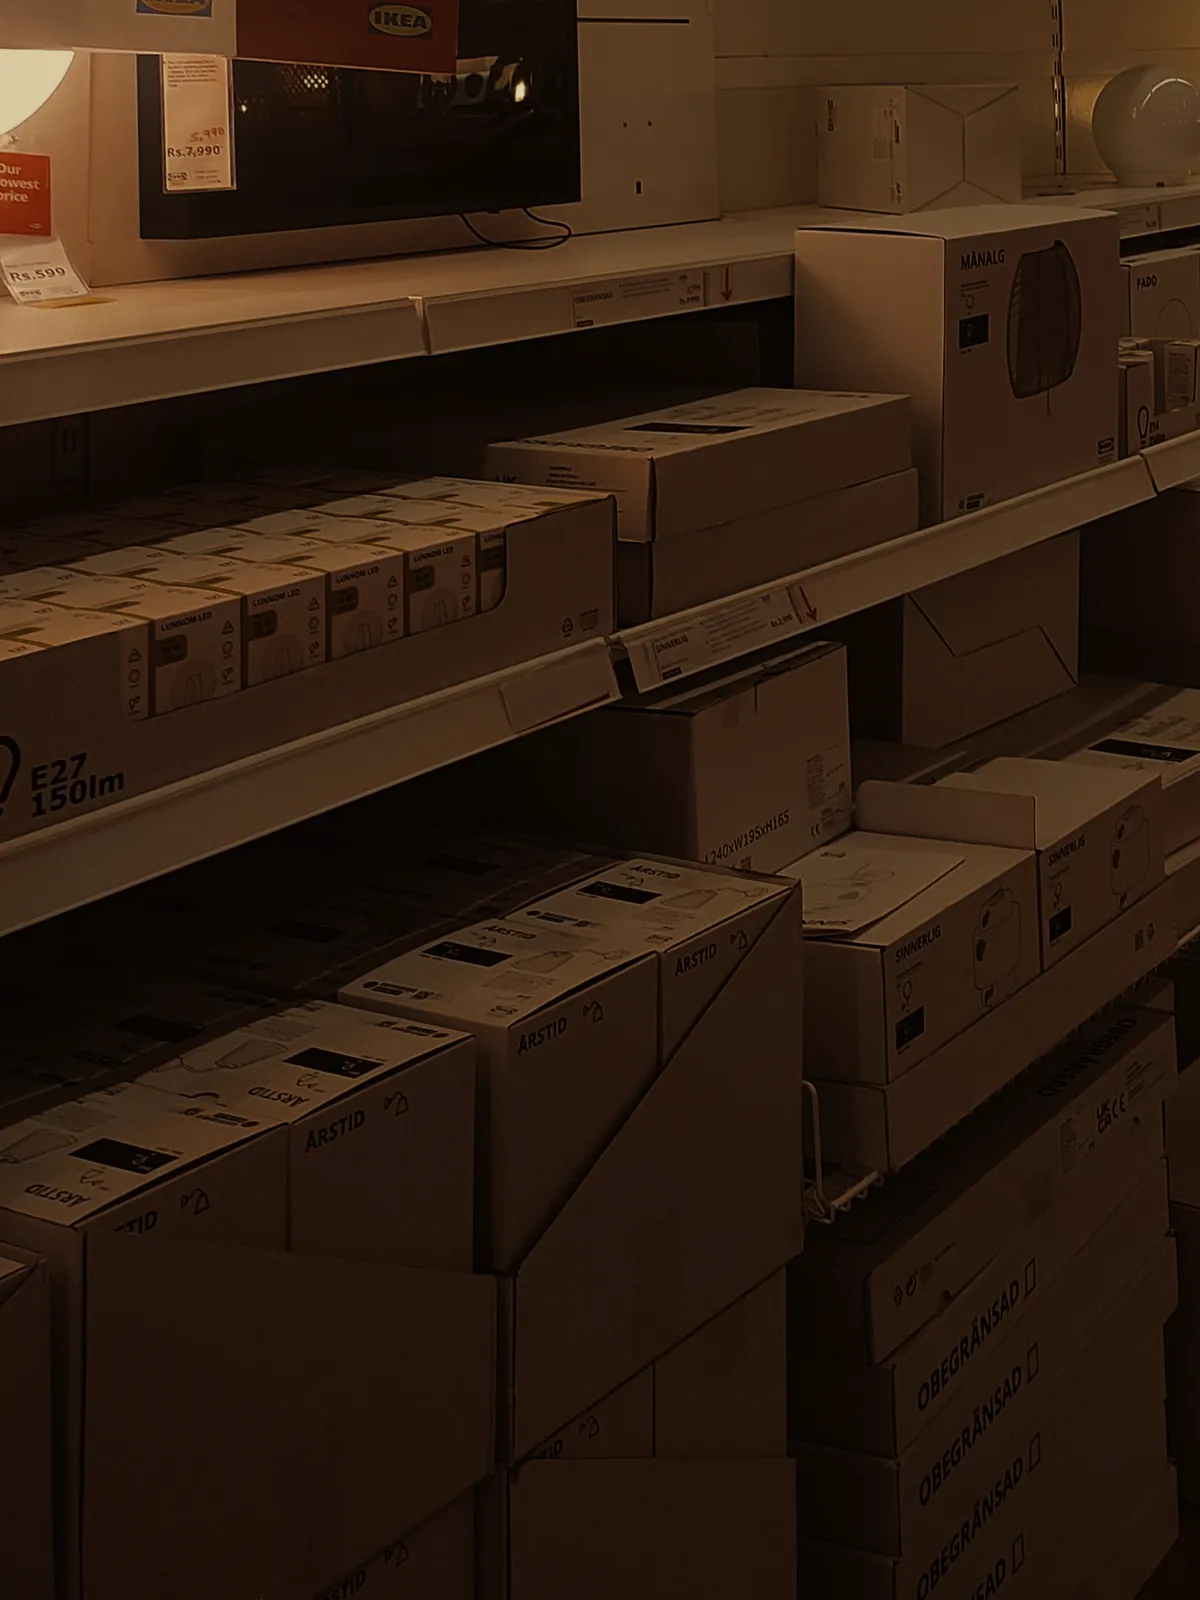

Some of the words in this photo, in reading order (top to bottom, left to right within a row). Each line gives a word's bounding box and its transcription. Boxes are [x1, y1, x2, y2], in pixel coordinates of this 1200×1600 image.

[374, 11, 429, 29] IKEA
[0, 177, 41, 191] owest
[10, 266, 66, 282] Rs.599
[1136, 274, 1158, 290] FADO
[31, 752, 88, 791] E27
[32, 772, 124, 818] 150lm
[895, 924, 941, 963] SINNERLIG
[918, 1279, 1019, 1412] OBEGRÄNSAD
[919, 1366, 1023, 1507] OBEGRÄNSAD
[917, 1457, 1024, 1600] OBEGRÄNSAD
